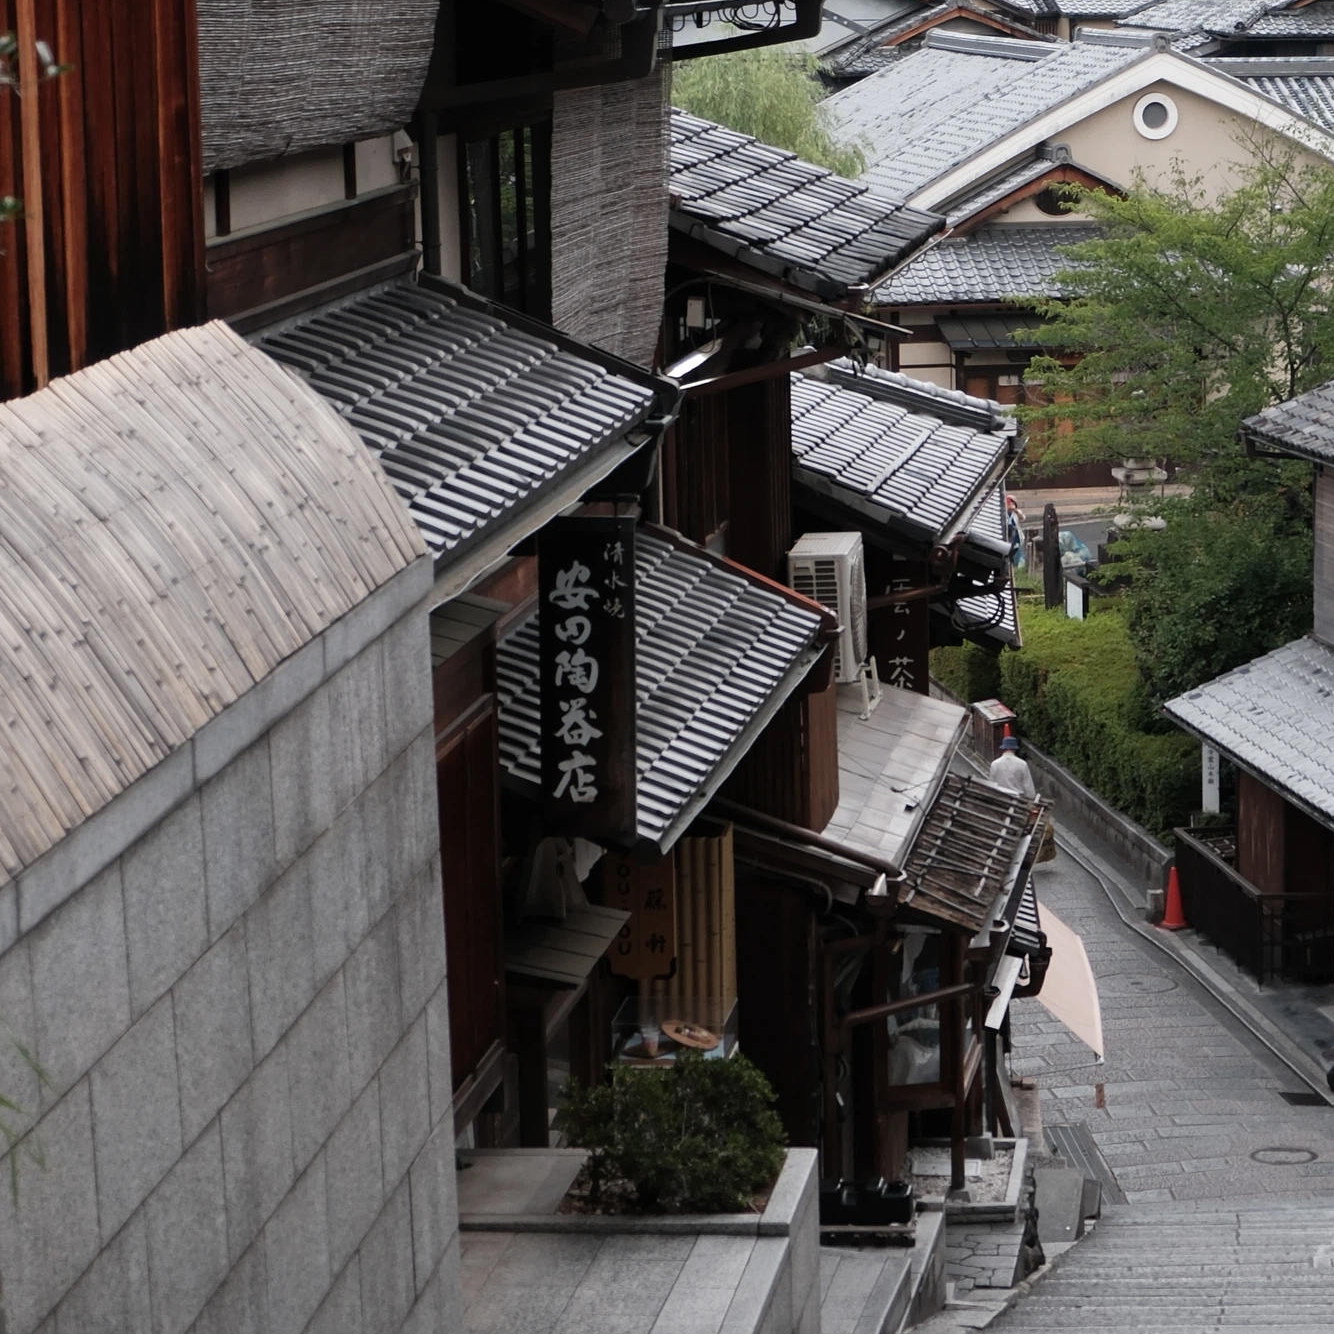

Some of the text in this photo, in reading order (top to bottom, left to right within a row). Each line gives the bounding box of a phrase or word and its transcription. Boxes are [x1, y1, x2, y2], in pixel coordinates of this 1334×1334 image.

[603, 541, 628, 618] 清水焼
[549, 560, 604, 803] 安田陶器店
